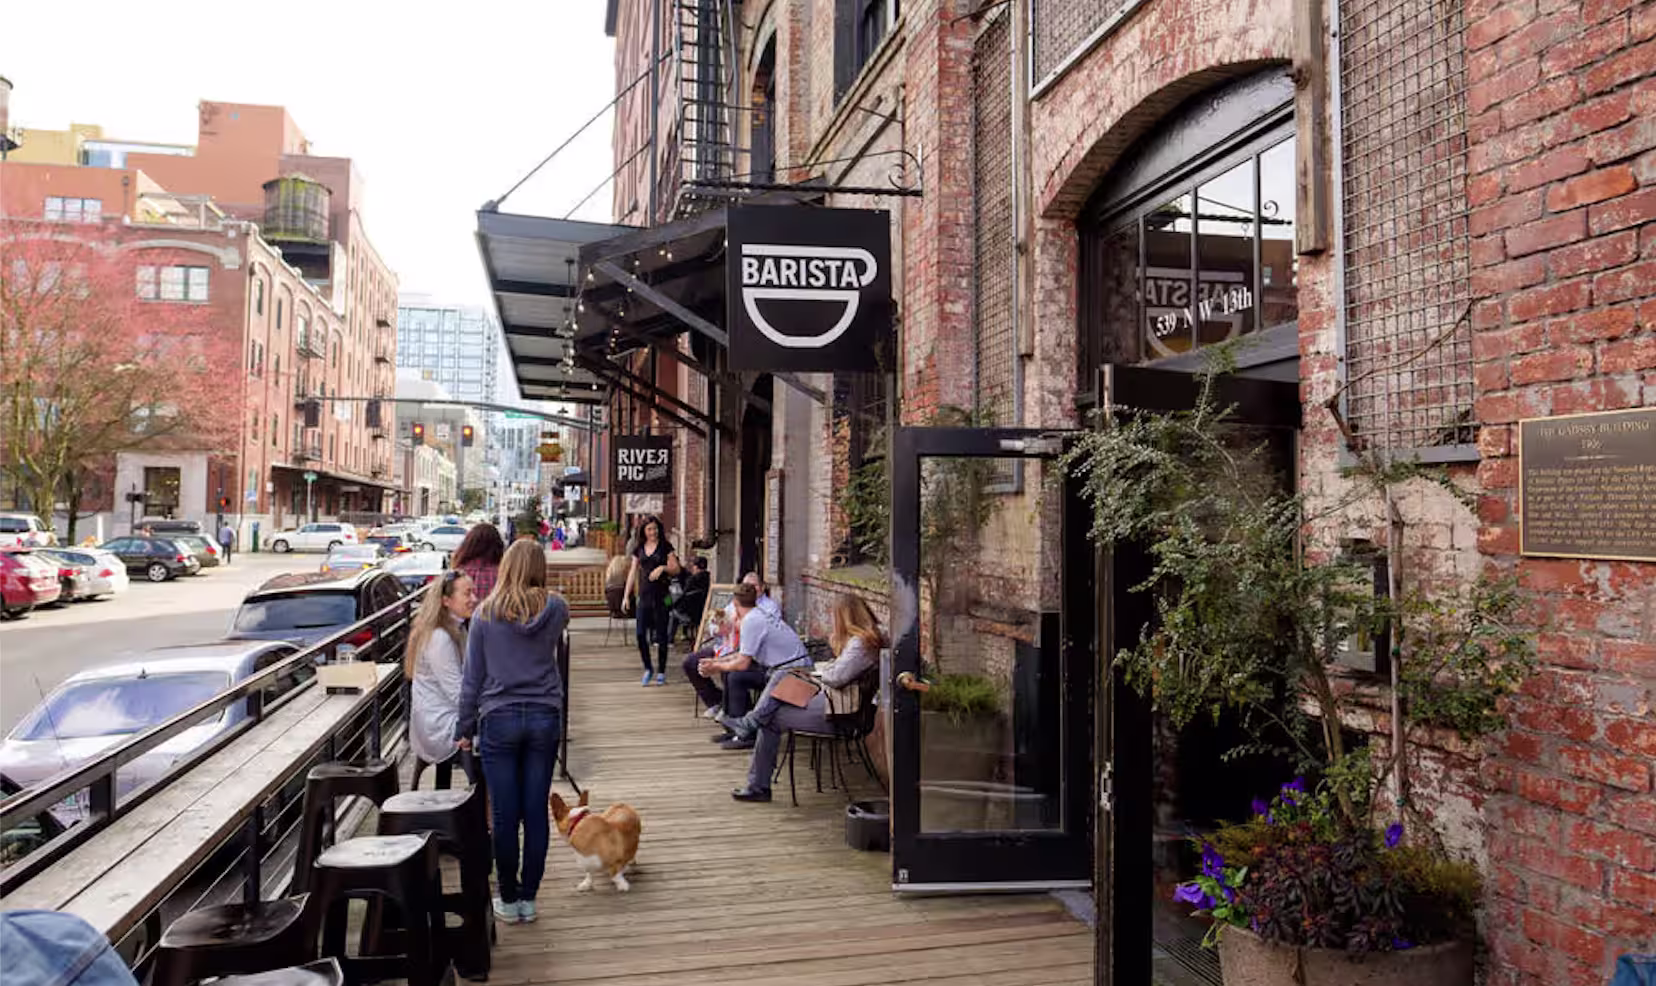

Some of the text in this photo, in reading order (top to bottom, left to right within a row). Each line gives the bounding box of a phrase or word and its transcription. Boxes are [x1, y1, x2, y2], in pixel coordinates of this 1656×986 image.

[742, 257, 860, 288] BARISTA
[1156, 312, 1177, 338] 539
[1223, 286, 1253, 315] 13th
[618, 465, 644, 481] PIG
